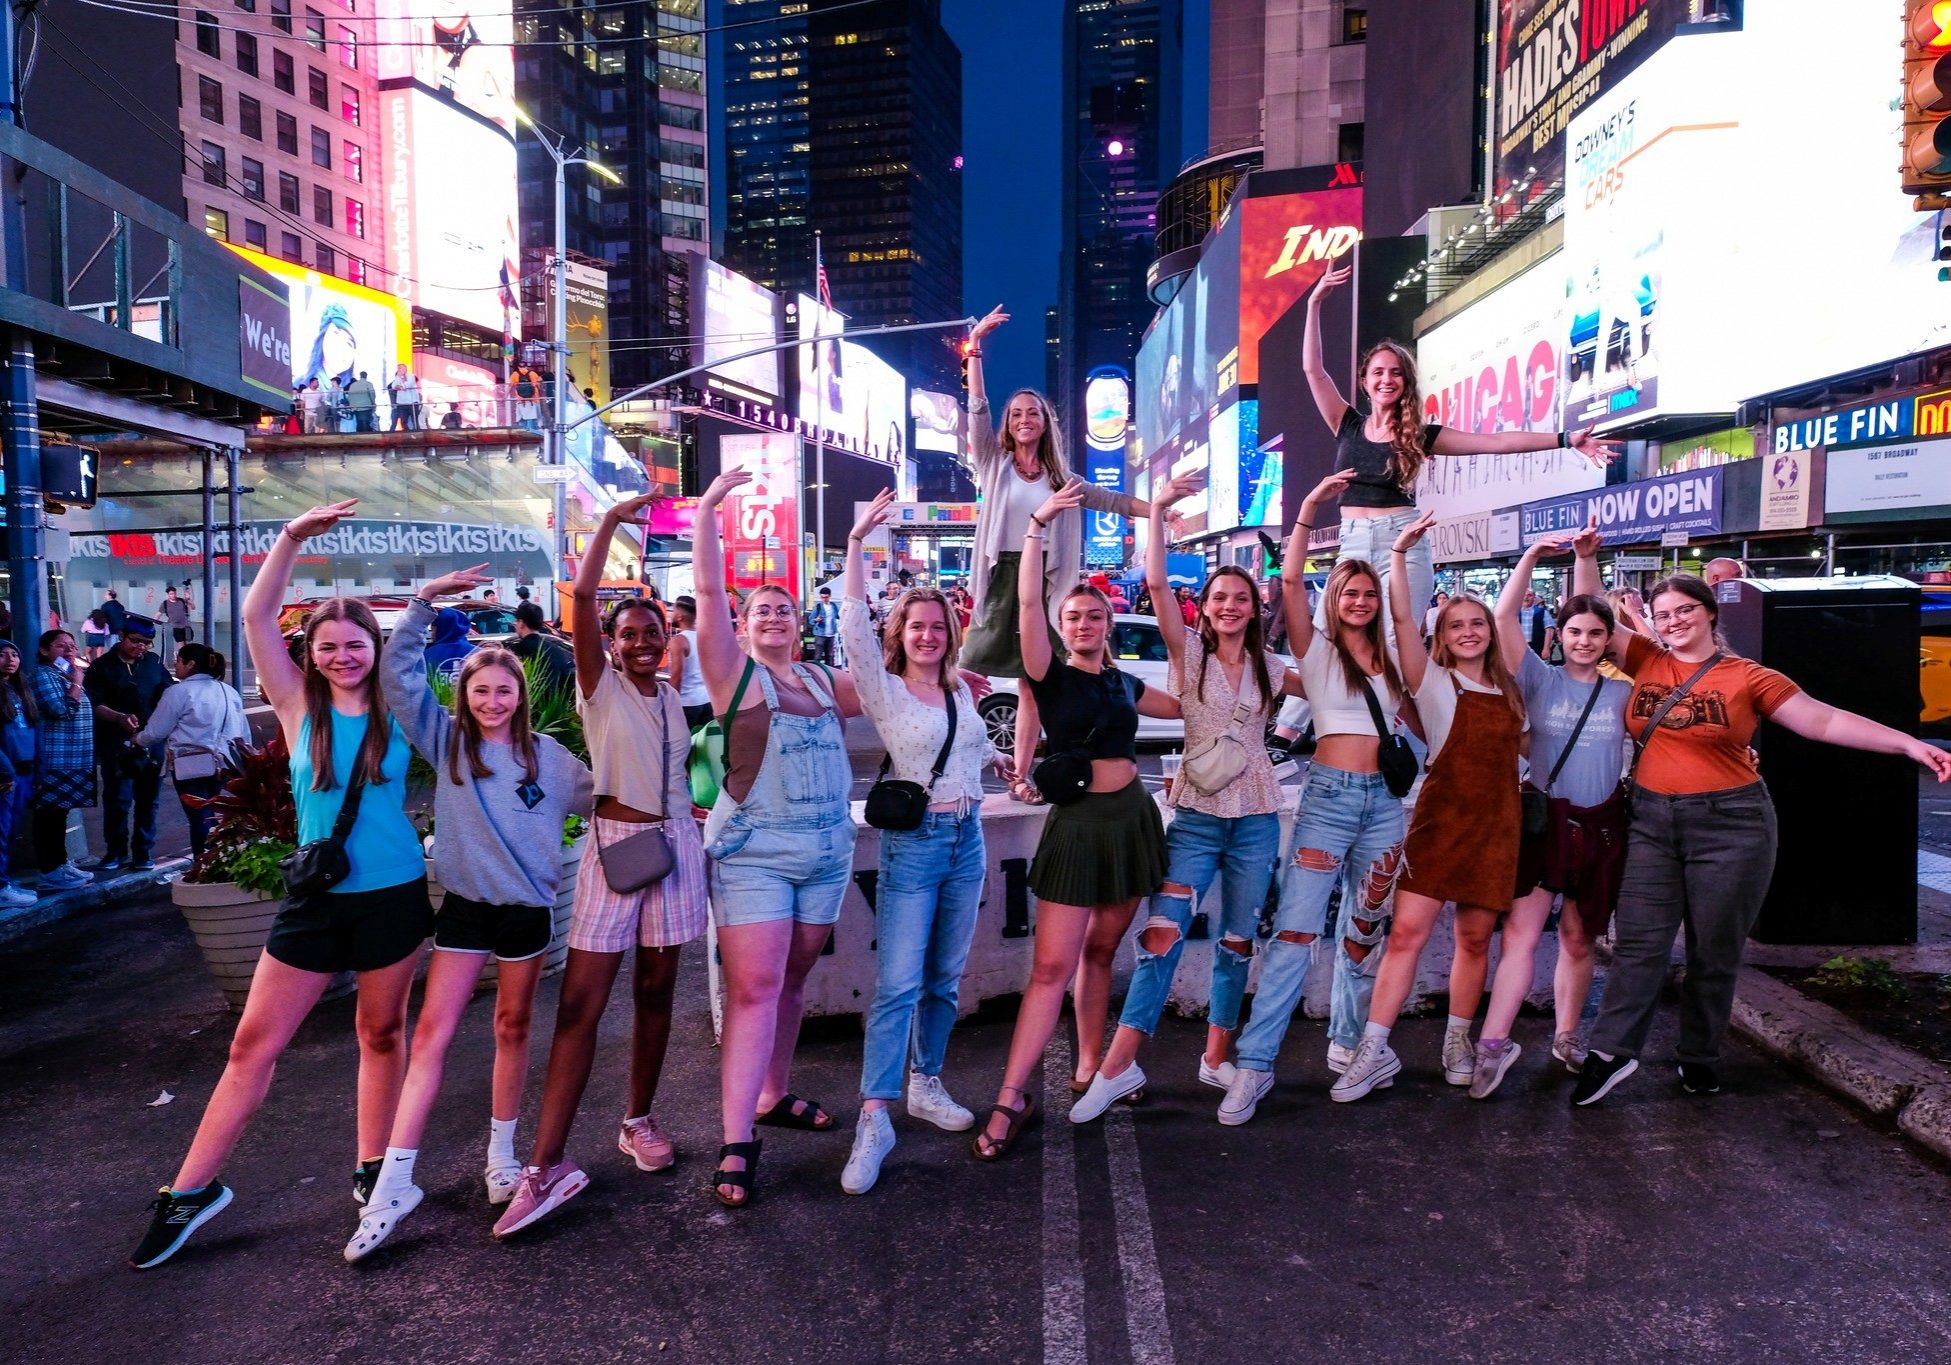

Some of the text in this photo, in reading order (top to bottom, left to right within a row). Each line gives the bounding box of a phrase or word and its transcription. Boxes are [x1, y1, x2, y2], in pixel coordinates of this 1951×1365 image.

[1533, 114, 1557, 154] BEST
[1575, 99, 1636, 163] DOWNEY'S
[1580, 124, 1634, 187] DREAM
[1585, 164, 1625, 210] CARS
[1264, 225, 1363, 279] IND
[244, 313, 291, 367] We're
[786, 316, 797, 324] LG
[738, 400, 789, 431] 1540
[1775, 402, 1899, 455] BLUE FIN
[1884, 448, 1919, 459] BROADWAY
[1524, 504, 1580, 533] BLUE FIN
[1588, 476, 1714, 526] NOW OPEN
[1669, 521, 1686, 531] CRAFT
[1685, 518, 1712, 529] COCKTAILS
